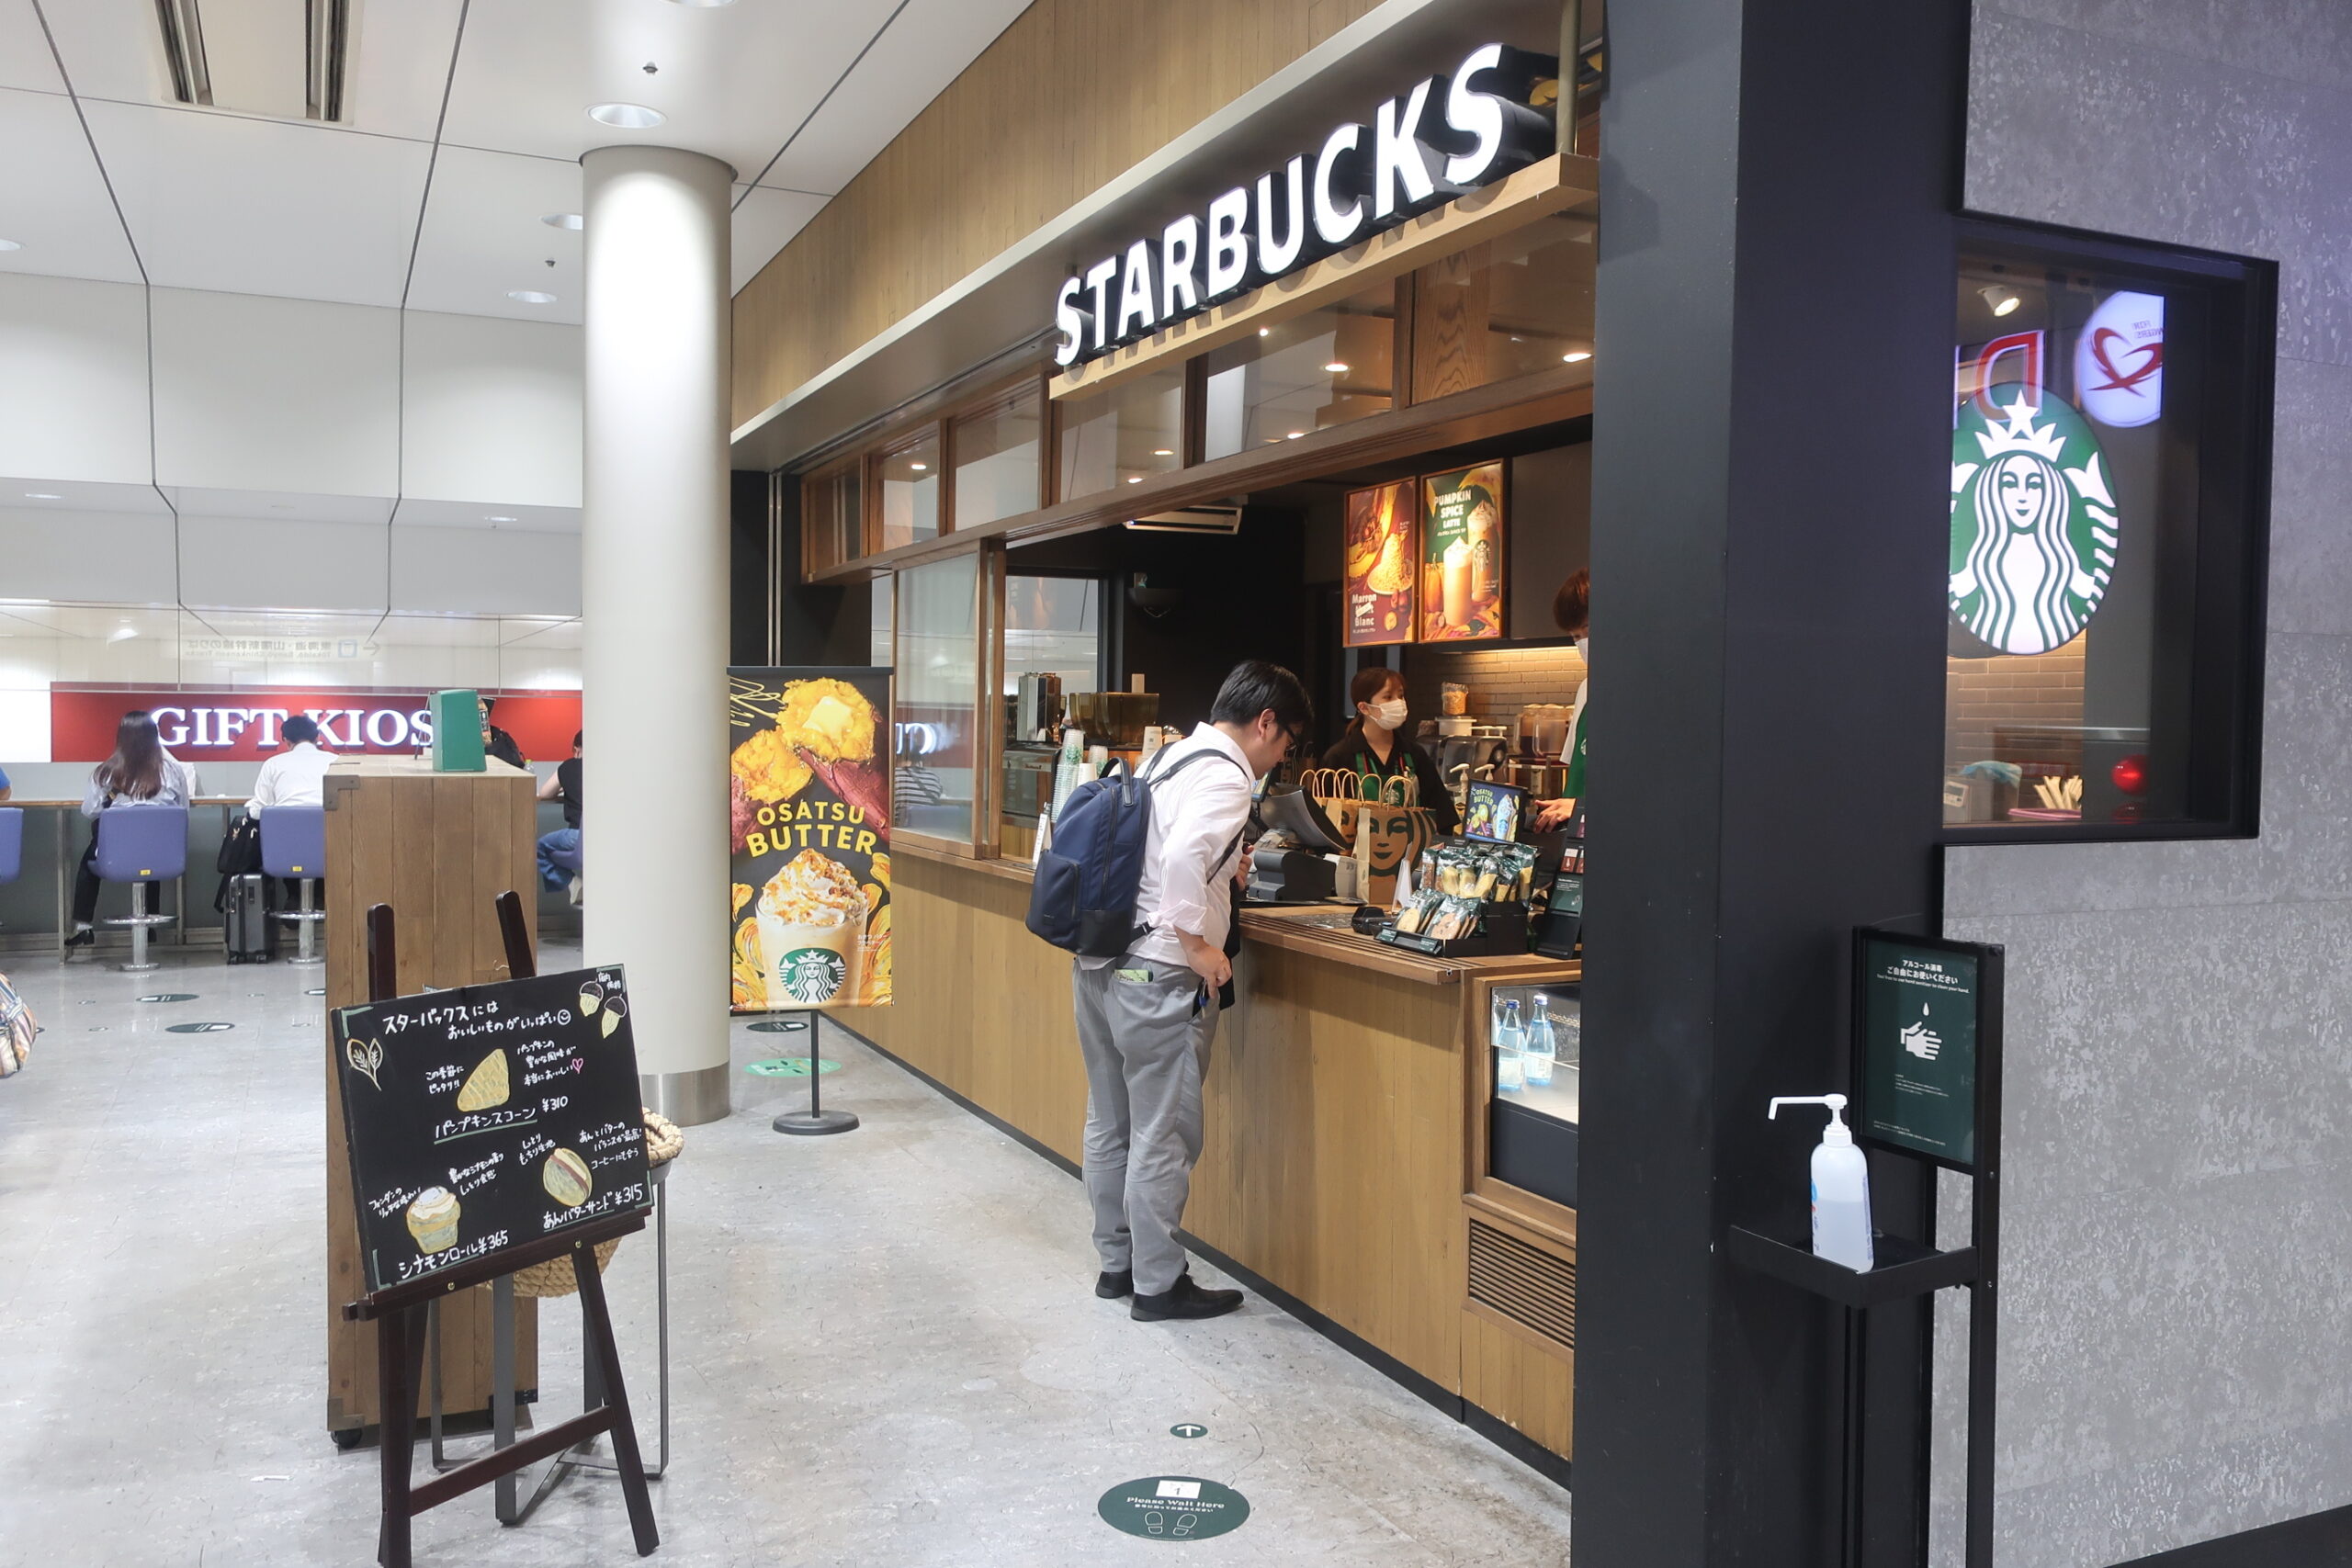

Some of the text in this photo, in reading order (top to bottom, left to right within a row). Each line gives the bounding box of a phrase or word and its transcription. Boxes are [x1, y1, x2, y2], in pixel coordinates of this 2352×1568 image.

[1055, 42, 1505, 367] STARBUCKS
[1434, 490, 1472, 506] PUMPKIN
[1441, 504, 1464, 519] SPICE
[1442, 518, 1461, 528] LATTE
[1351, 593, 1377, 604] Marron
[1355, 617, 1374, 626] Blanc
[150, 707, 434, 747] GIFT KIOS
[757, 799, 865, 826] OSATSU
[746, 824, 876, 857] BUTTER
[1887, 966, 1958, 984] ご自由にお使いください
[1902, 960, 1942, 972] アルコール消毒
[382, 1000, 499, 1035] スターバックスには
[447, 1012, 556, 1040] おいしいものがいっぱい
[425, 1065, 465, 1080] この季節に
[524, 1066, 573, 1087] 本当においしい
[435, 1096, 569, 1138] パンプキンスコーン ¥310
[579, 1122, 626, 1144] あんとバターの
[591, 1147, 639, 1170] コーヒーにも合う
[543, 1182, 643, 1229] あんバターサンド ¥315
[398, 1229, 508, 1280] シナモンロール ¥365
[1126, 1496, 1164, 1505] Please
[1167, 1499, 1193, 1507] Wait
